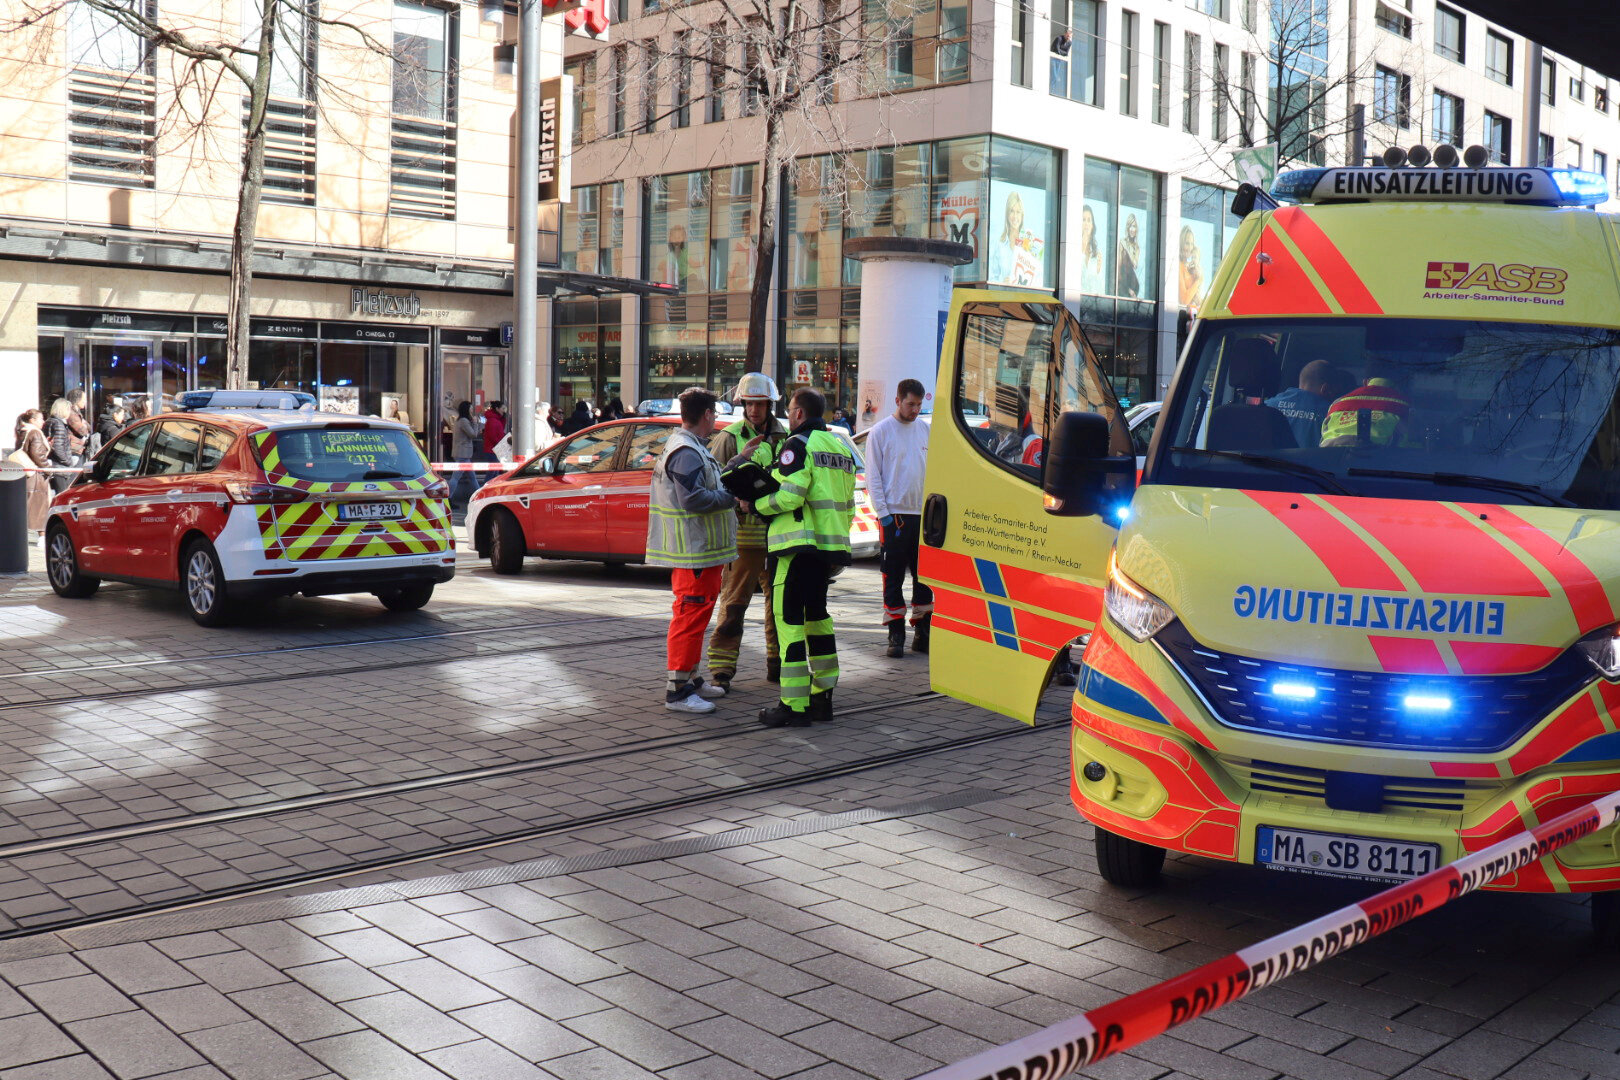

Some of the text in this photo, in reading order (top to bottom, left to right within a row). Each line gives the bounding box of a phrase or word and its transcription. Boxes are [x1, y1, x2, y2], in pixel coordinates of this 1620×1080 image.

[1334, 172, 1533, 196] EINSATZLEITUNG
[941, 196, 979, 208] Müller
[1456, 263, 1568, 295] ASB
[1423, 291, 1564, 306] Arbeiter-Samariter-Bund
[435, 310, 449, 318] 1897
[267, 325, 303, 333] ZENITH
[1277, 401, 1295, 409] ELW
[322, 434, 382, 443] FEUERWEHR
[325, 444, 387, 453] MANNHEIM
[357, 455, 377, 463] 112
[349, 504, 397, 516] MA F 239
[964, 508, 1048, 534] Arbeiter-Samariter-Bund
[963, 521, 1032, 547] Baden-Württemberg
[962, 534, 985, 548] Region
[986, 541, 1024, 557] Mannheim
[1032, 550, 1082, 570] Rhein-Neckar
[1274, 834, 1432, 877] MA SB 8111
[1266, 864, 1285, 872] IVECO
